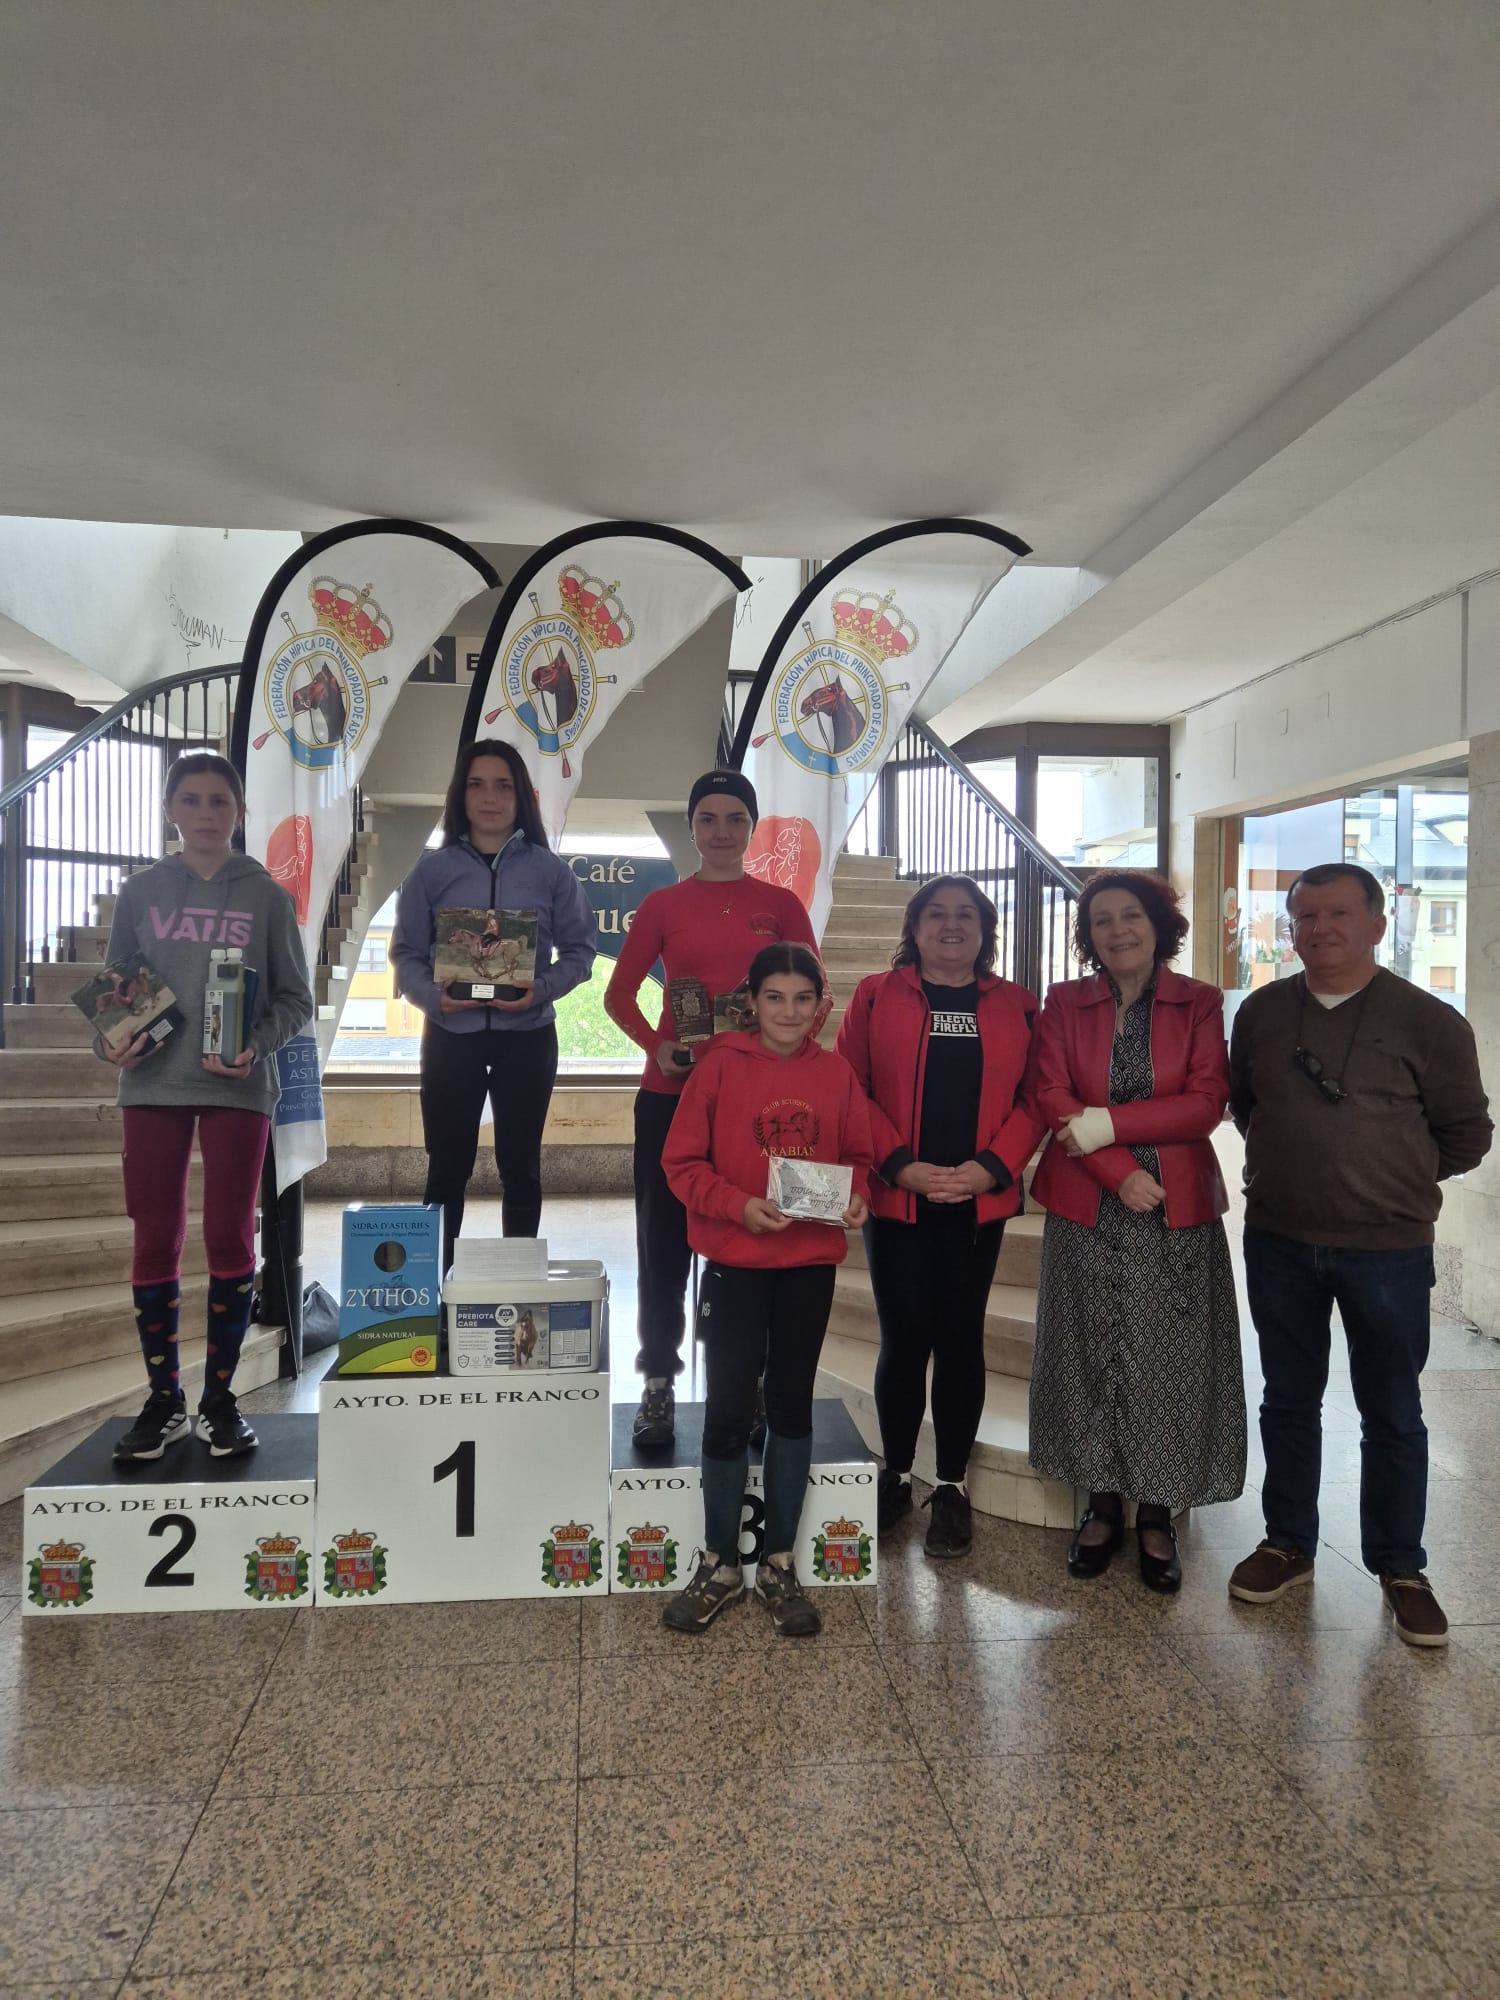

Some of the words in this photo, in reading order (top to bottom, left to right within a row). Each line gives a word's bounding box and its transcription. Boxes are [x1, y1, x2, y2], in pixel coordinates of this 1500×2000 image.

[508, 634, 533, 696] FEDERACIÓN
[558, 621, 573, 639] DEL
[803, 646, 833, 666] HÍPICA
[834, 649, 850, 665] DEL
[271, 656, 292, 719] FEDERACIÓN
[318, 637, 335, 651] DEL
[352, 706, 365, 720] DE
[850, 658, 882, 711] PRINCIPADO
[778, 663, 805, 724] FEDERACIÓN
[872, 711, 882, 726] DE
[845, 728, 879, 767] ASTURIAS
[567, 855, 636, 884] Café
[150, 906, 255, 947] VANS
[933, 1014, 977, 1024] ELECTR
[933, 1022, 978, 1033] FIREFLY
[351, 1222, 379, 1230] SIDRA
[346, 1287, 430, 1308] ZYTHOS
[333, 1395, 409, 1409] AYTO.
[418, 1393, 453, 1406] DE
[460, 1392, 488, 1404] EL
[495, 1388, 600, 1403] FRANCO
[433, 1440, 476, 1537] 1
[617, 1478, 691, 1491] AYTO.
[807, 1473, 873, 1486] ANCO
[31, 1501, 111, 1515] AYTO.
[121, 1500, 156, 1511] DE
[164, 1498, 193, 1510] EL
[199, 1494, 309, 1508] FRANCO
[738, 1493, 765, 1565] 3
[144, 1514, 197, 1587] 2
